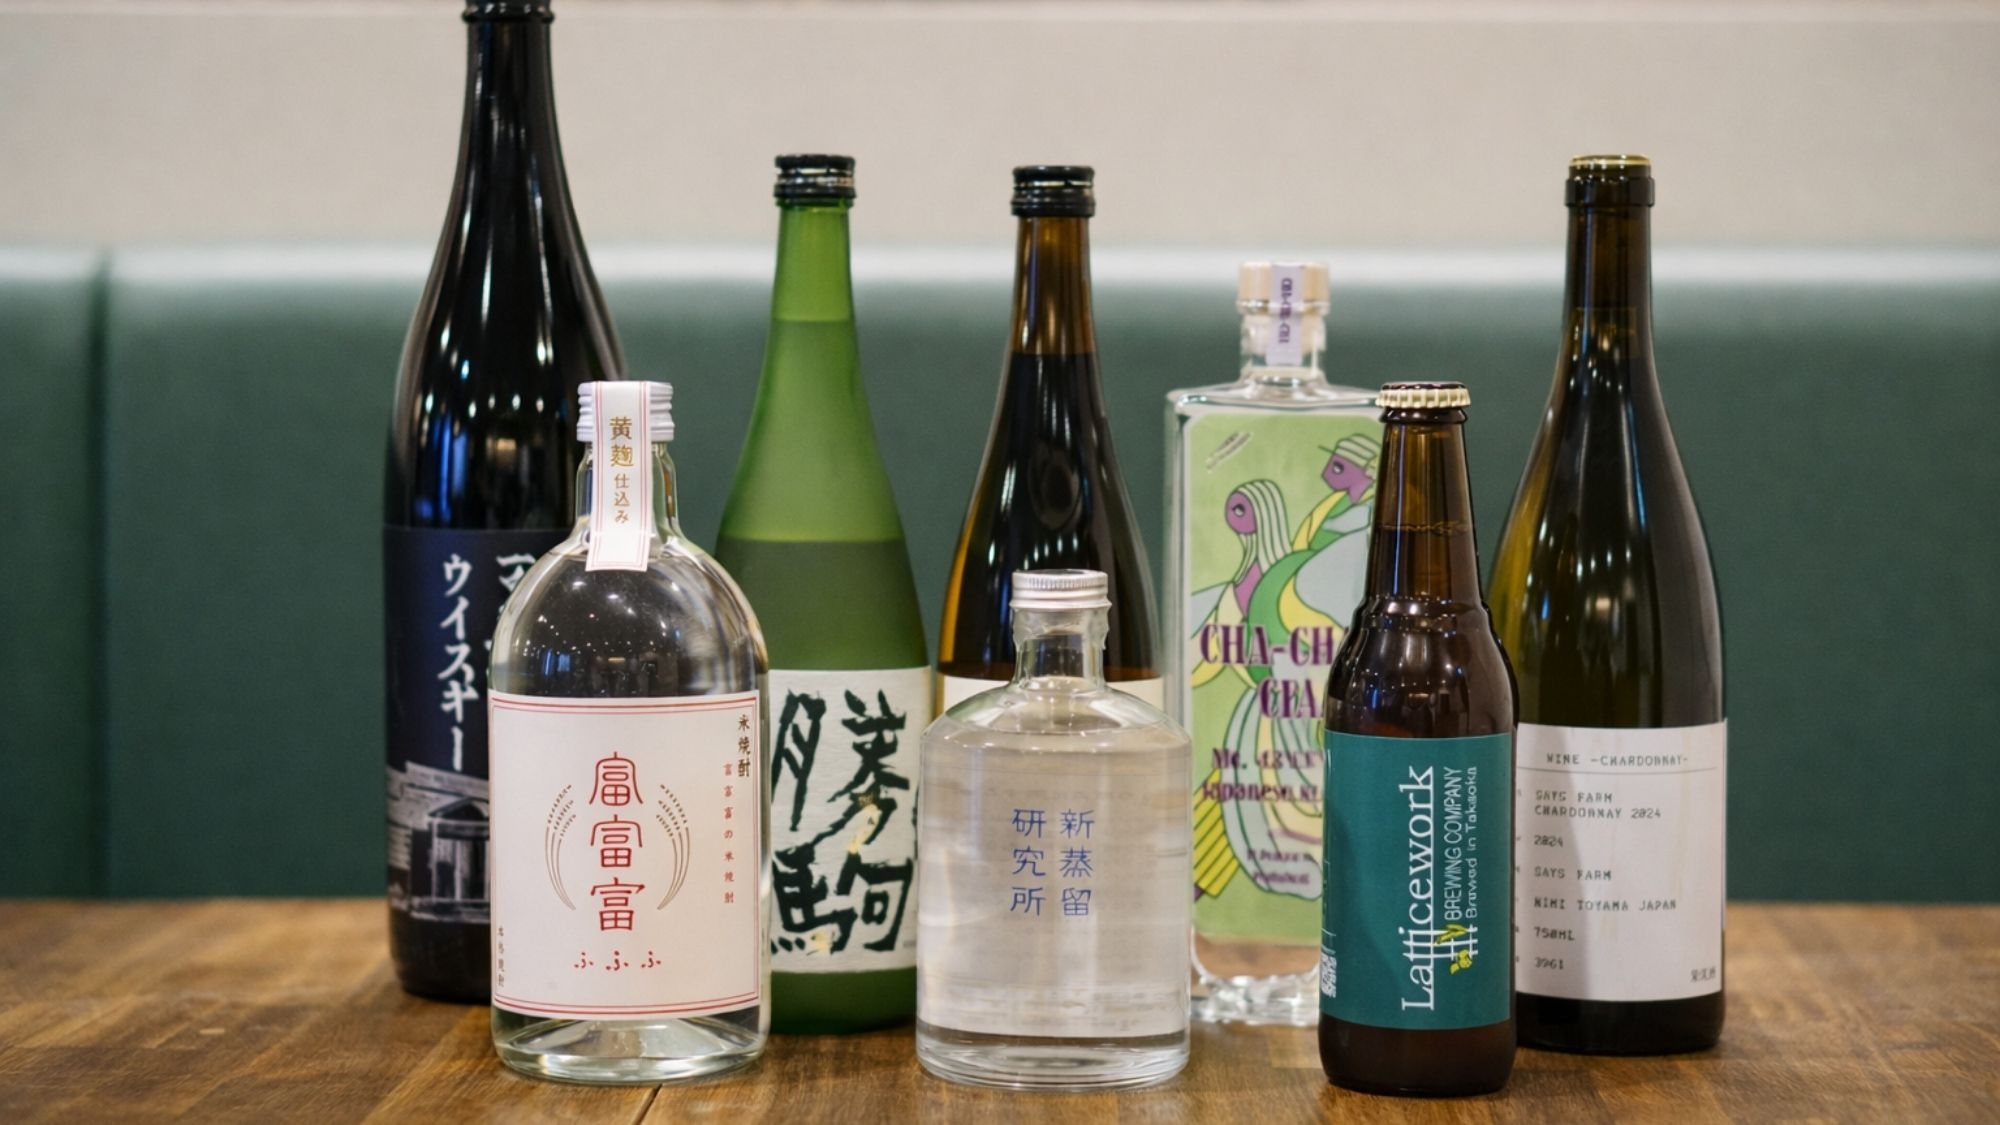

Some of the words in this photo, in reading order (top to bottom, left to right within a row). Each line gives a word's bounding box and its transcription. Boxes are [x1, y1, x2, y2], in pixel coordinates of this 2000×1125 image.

[437, 553, 479, 772] ウイスキー
[1200, 624, 1349, 667] CHA-CH
[1546, 753, 1580, 765] WINE
[1443, 765, 1463, 844] COMPANY
[1465, 766, 1478, 834] Takaoka
[1534, 805, 1622, 819] CHARDONNAY
[1630, 808, 1662, 819] 2024
[1535, 789, 1567, 801] SAYS
[1577, 792, 1613, 803] FARM
[588, 751, 645, 931] 富富富
[1010, 808, 1047, 916] 研究所
[1059, 808, 1095, 916] 新蒸留
[1466, 836, 1477, 851] in
[1533, 834, 1564, 848] 2024
[1399, 765, 1434, 1011] Latticework
[1443, 847, 1463, 921] BREWING
[1465, 857, 1478, 919] Brewed
[1534, 866, 1566, 879] SAYS
[1576, 869, 1613, 881] FARM
[1577, 900, 1630, 912] TOYAMA
[1639, 899, 1677, 912] JAPAN
